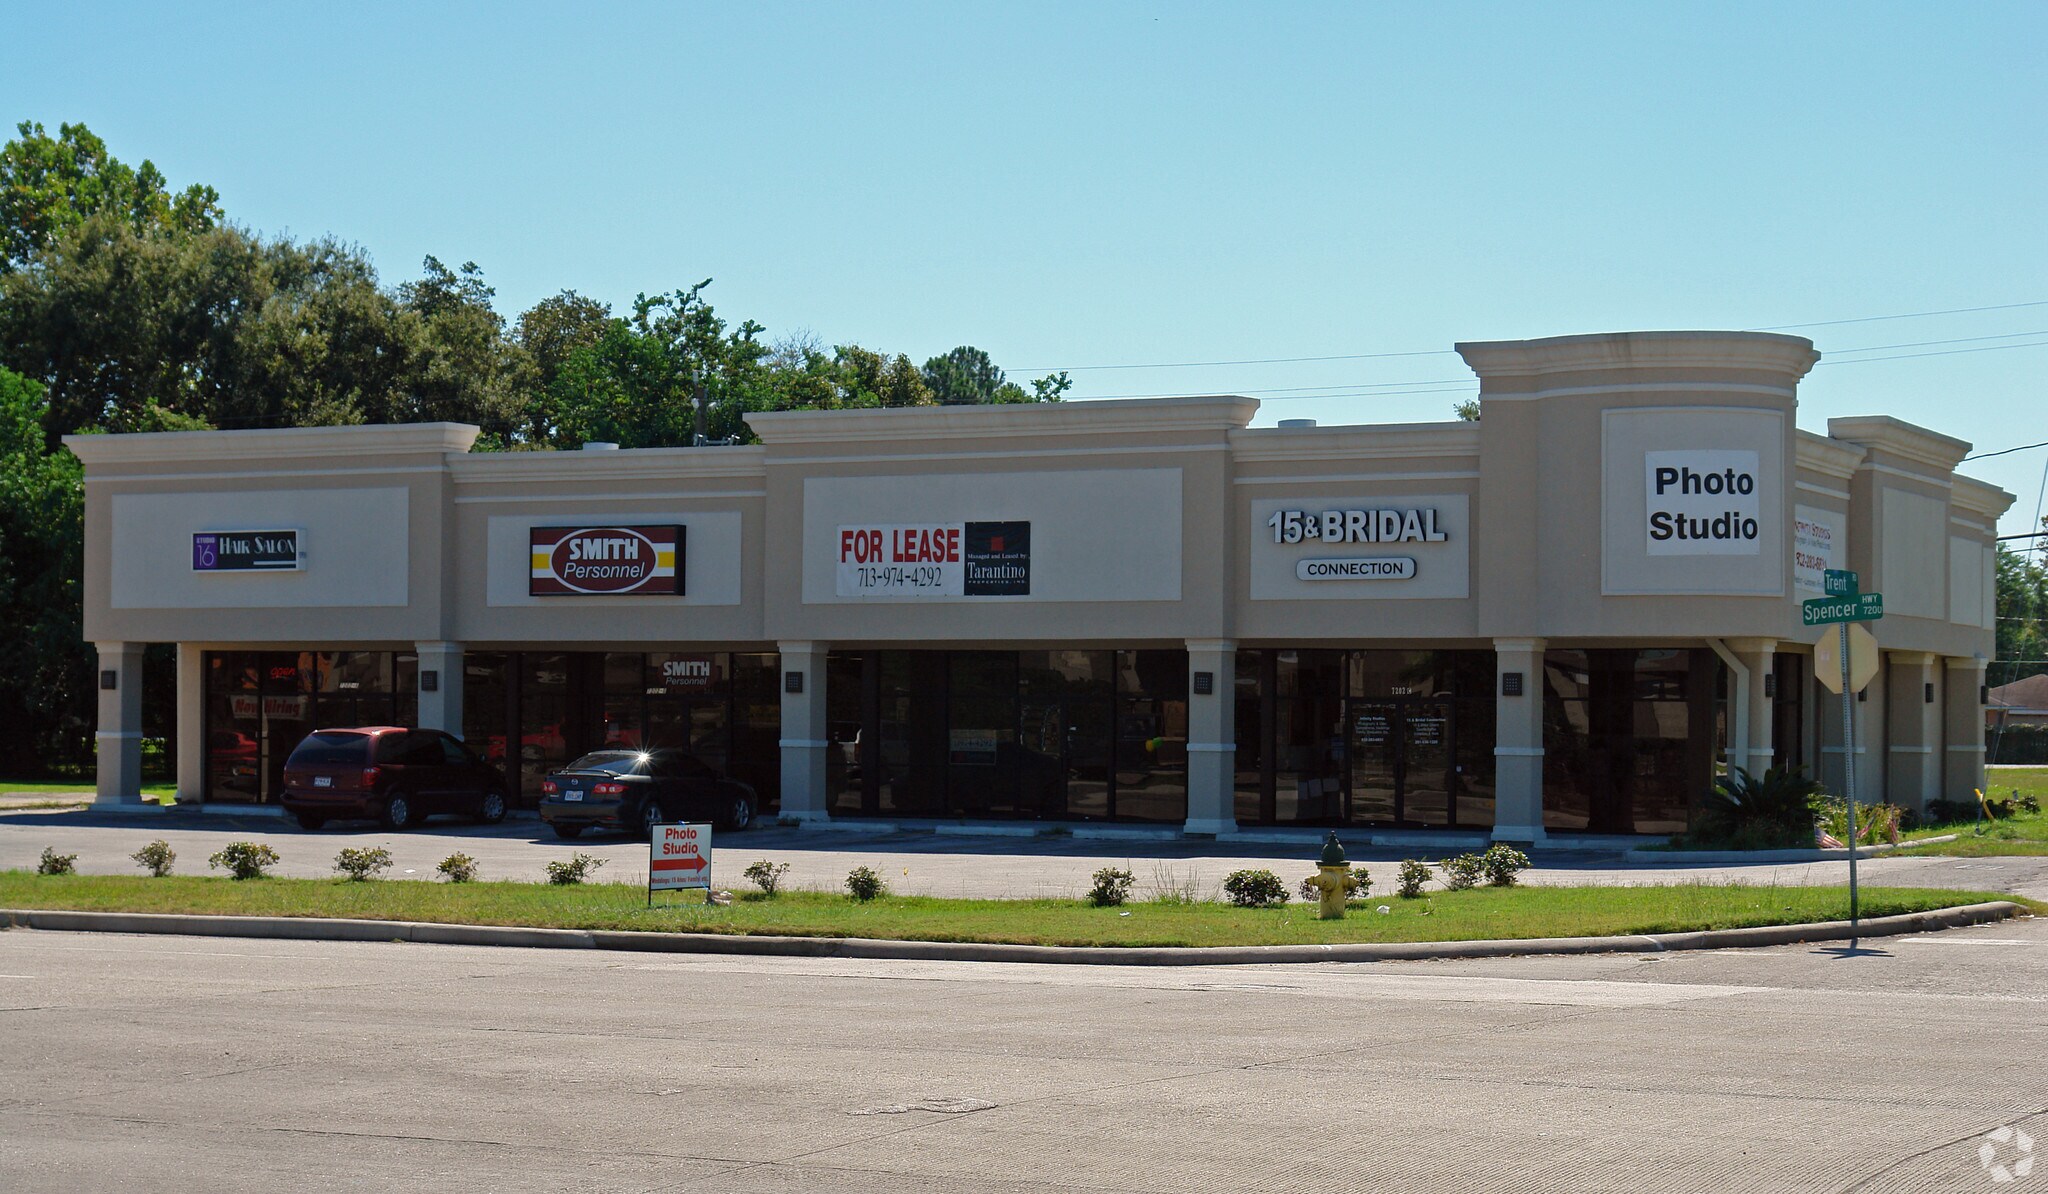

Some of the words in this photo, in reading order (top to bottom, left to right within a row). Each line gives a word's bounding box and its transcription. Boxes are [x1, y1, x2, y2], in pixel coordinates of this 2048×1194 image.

[1655, 467, 1754, 495] Photo
[1649, 511, 1758, 541] Studio
[569, 538, 638, 560] SMITH
[841, 529, 883, 564] FOR
[893, 528, 960, 563] LEASE
[197, 545, 215, 567] 16
[563, 561, 645, 579] Personnel
[858, 566, 942, 587] 713-974-4292
[967, 561, 1026, 579] Tarantino
[1307, 562, 1403, 576] CONNECTION
[1825, 574, 1847, 591] Trent
[1862, 594, 1878, 604] HWY
[1804, 603, 1857, 623] Spencer
[662, 661, 710, 676] SMITH
[665, 676, 708, 686] Personnel
[665, 827, 697, 840] Photo
[662, 841, 699, 855] Studio
